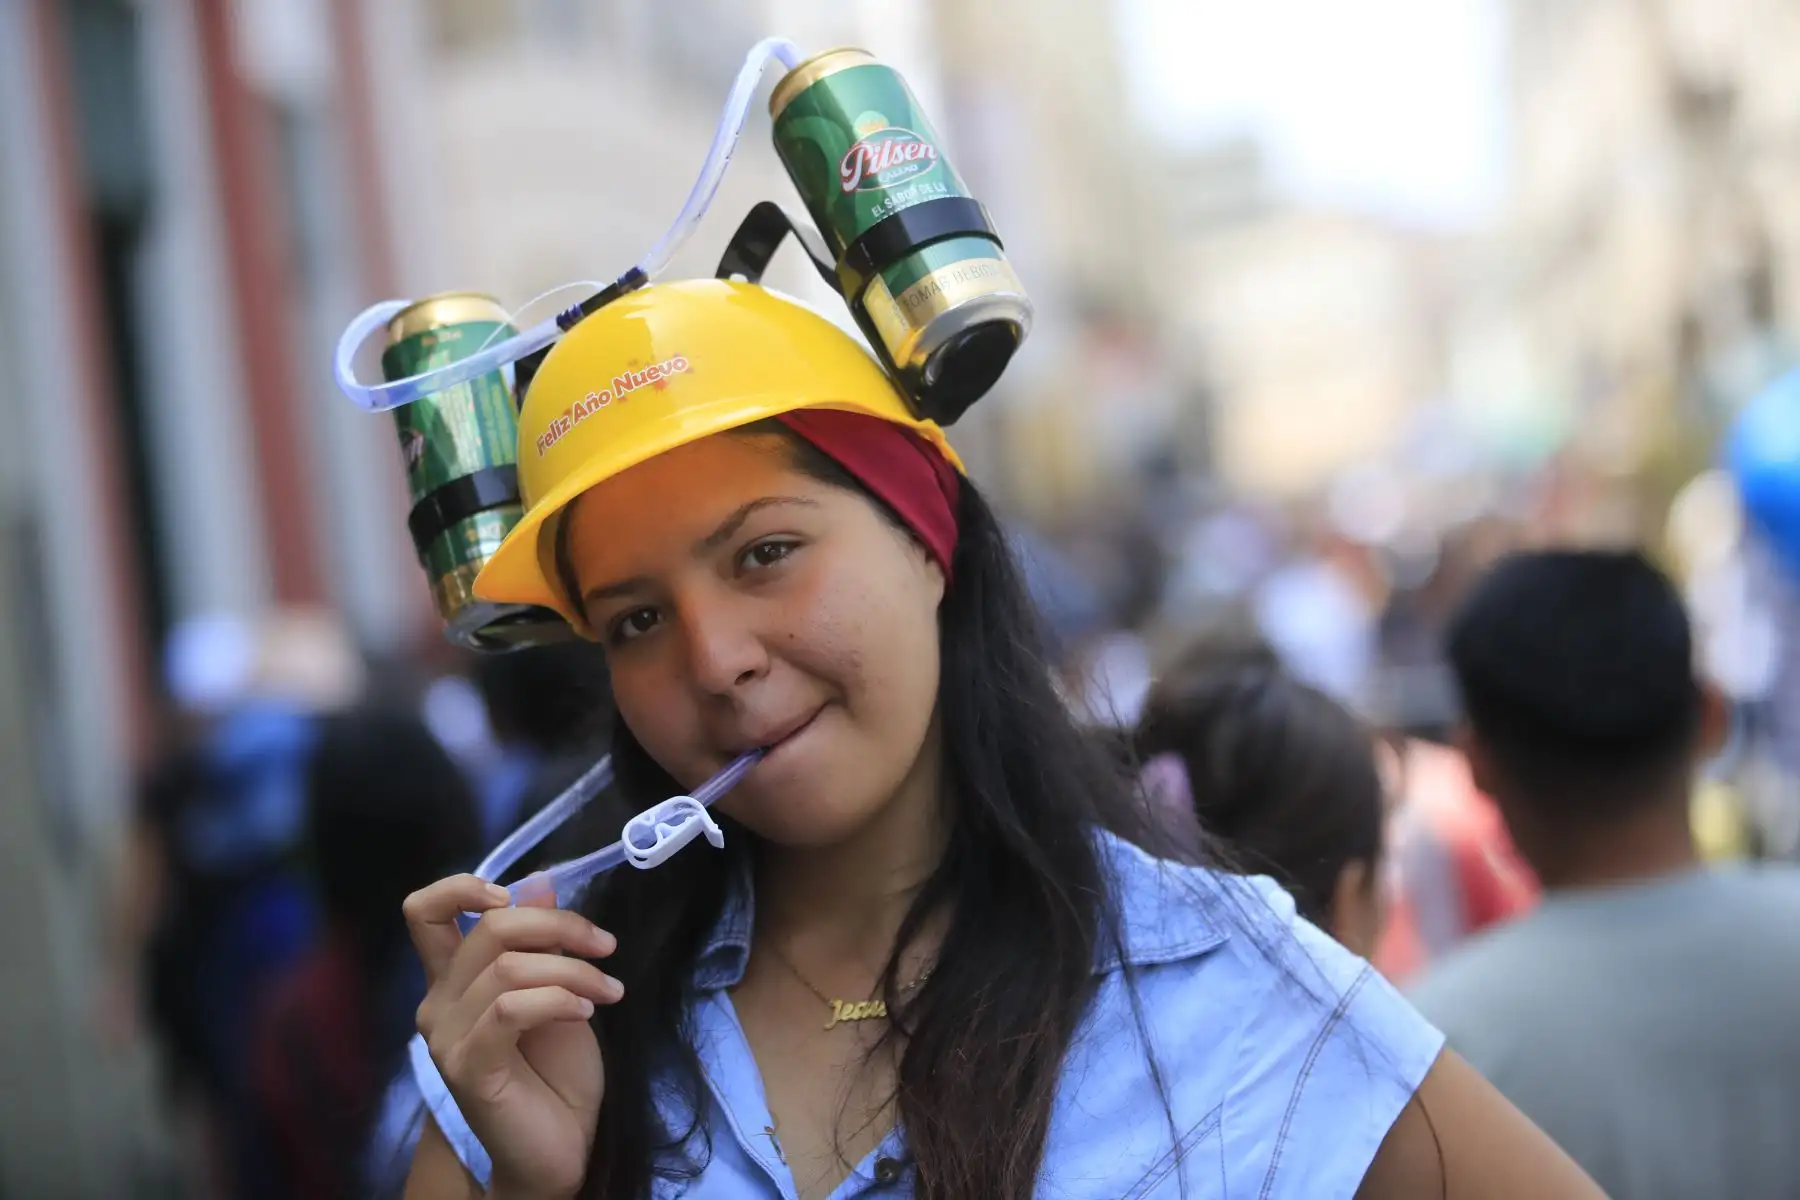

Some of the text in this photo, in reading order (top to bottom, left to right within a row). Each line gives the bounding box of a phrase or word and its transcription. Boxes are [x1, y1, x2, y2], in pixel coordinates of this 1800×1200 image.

[840, 139, 937, 193] Pilsen
[871, 204, 885, 217] EL
[884, 183, 918, 209] SABOR
[918, 183, 933, 195] DE
[536, 415, 571, 458] Feliz
[572, 389, 613, 425] Año
[611, 356, 689, 399] Nuevo
